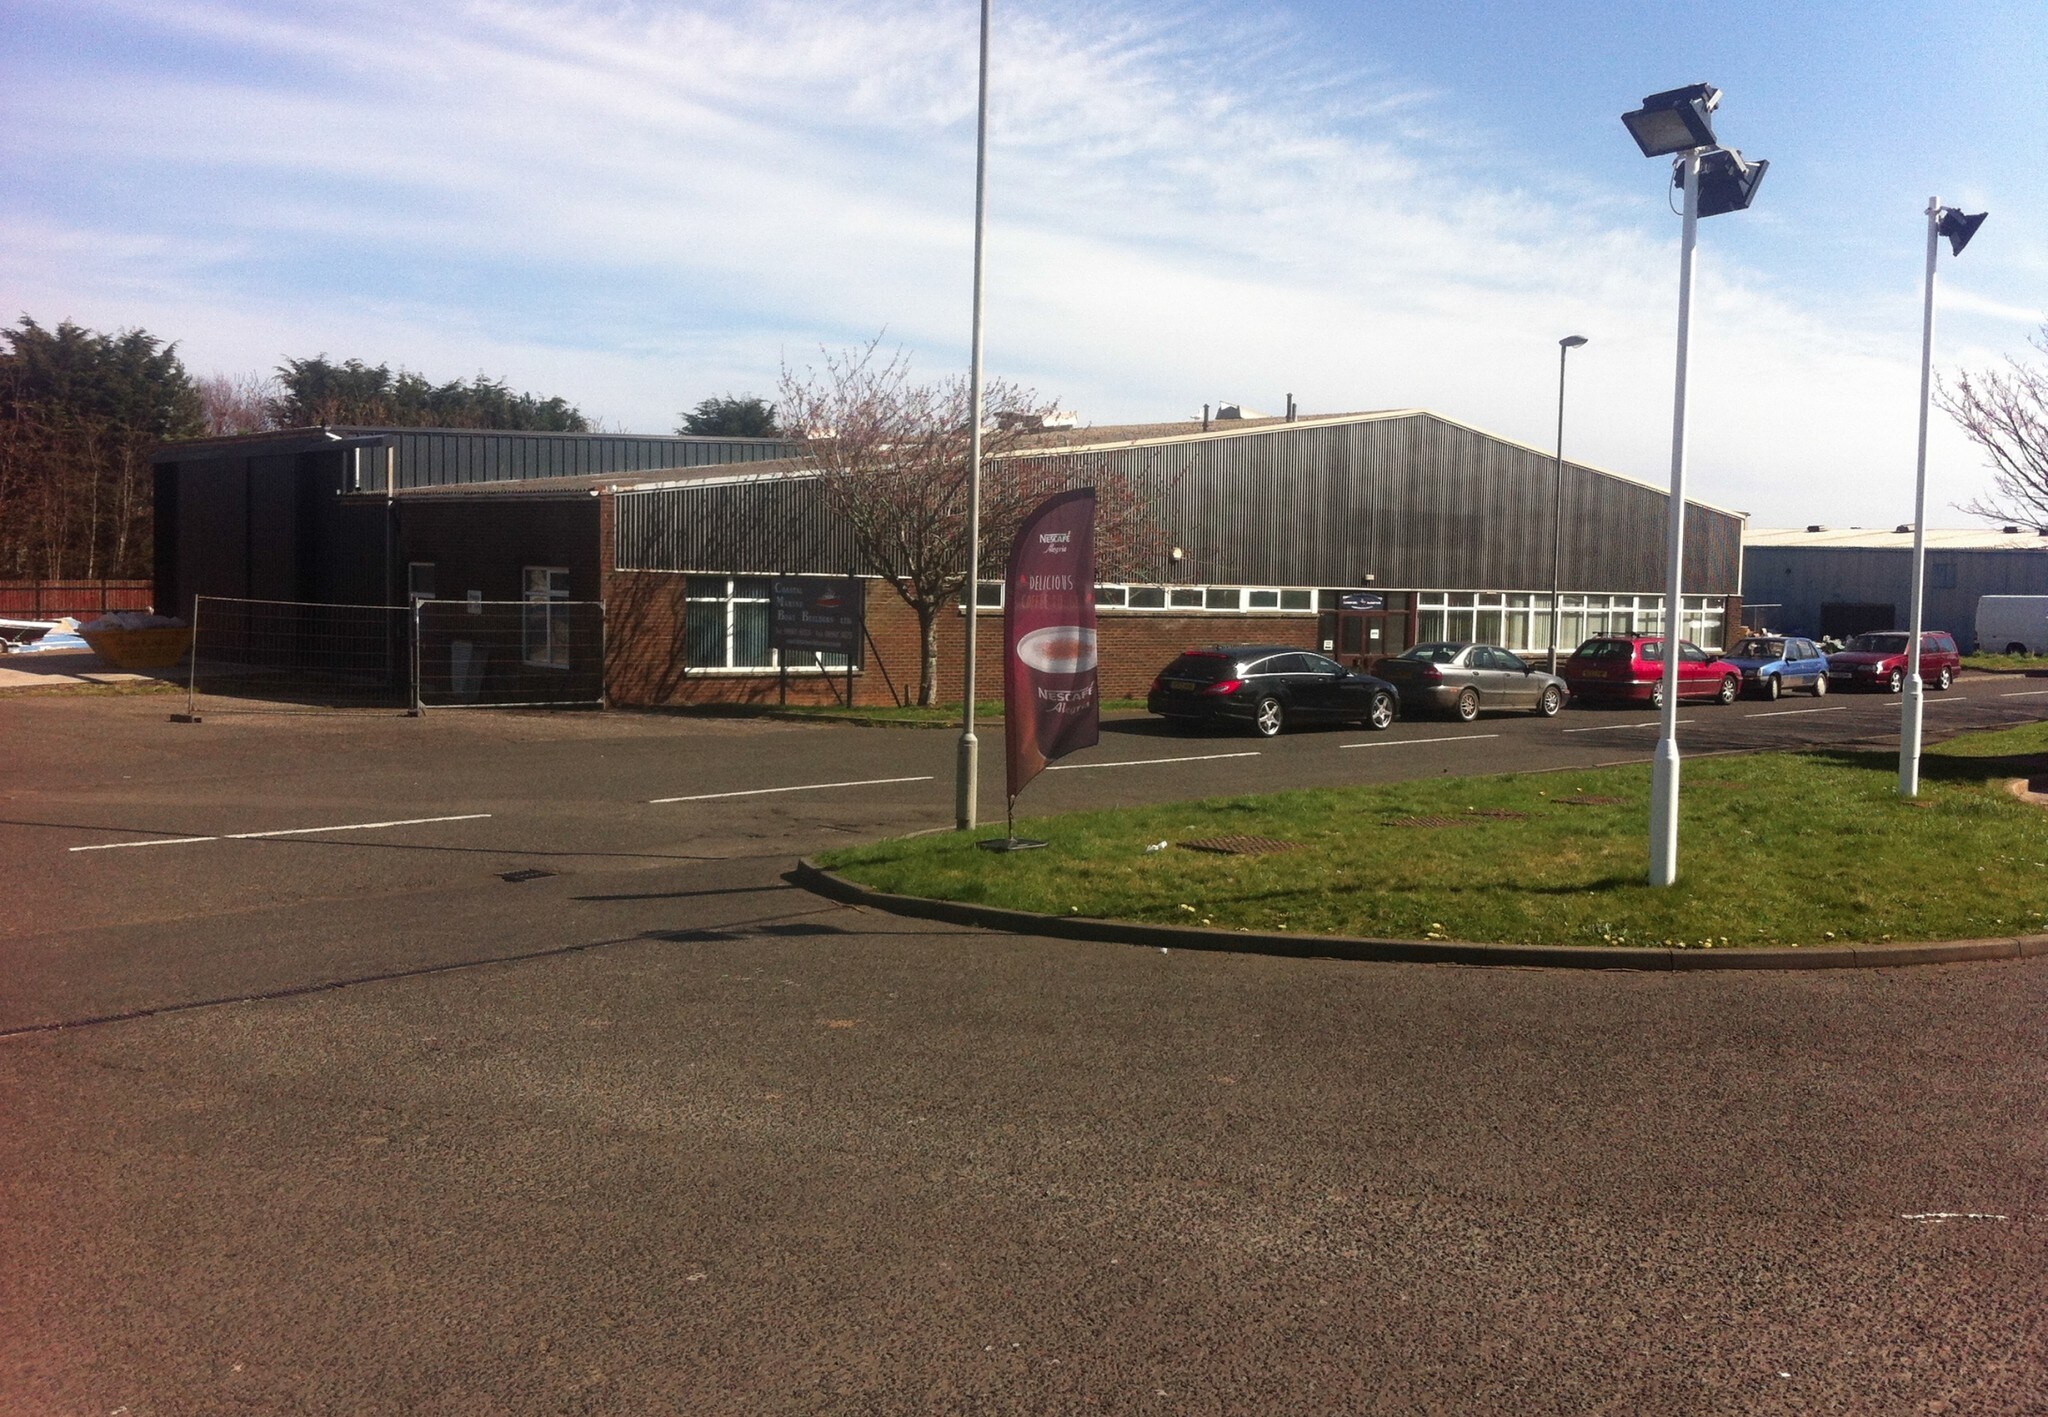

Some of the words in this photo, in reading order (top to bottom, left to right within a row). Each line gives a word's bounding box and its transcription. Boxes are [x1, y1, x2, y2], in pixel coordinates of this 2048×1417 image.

[1039, 530, 1071, 543] NESCAFÉ
[1029, 574, 1074, 590] DELICIOUS
[1037, 680, 1095, 702] NESCAFÉ
